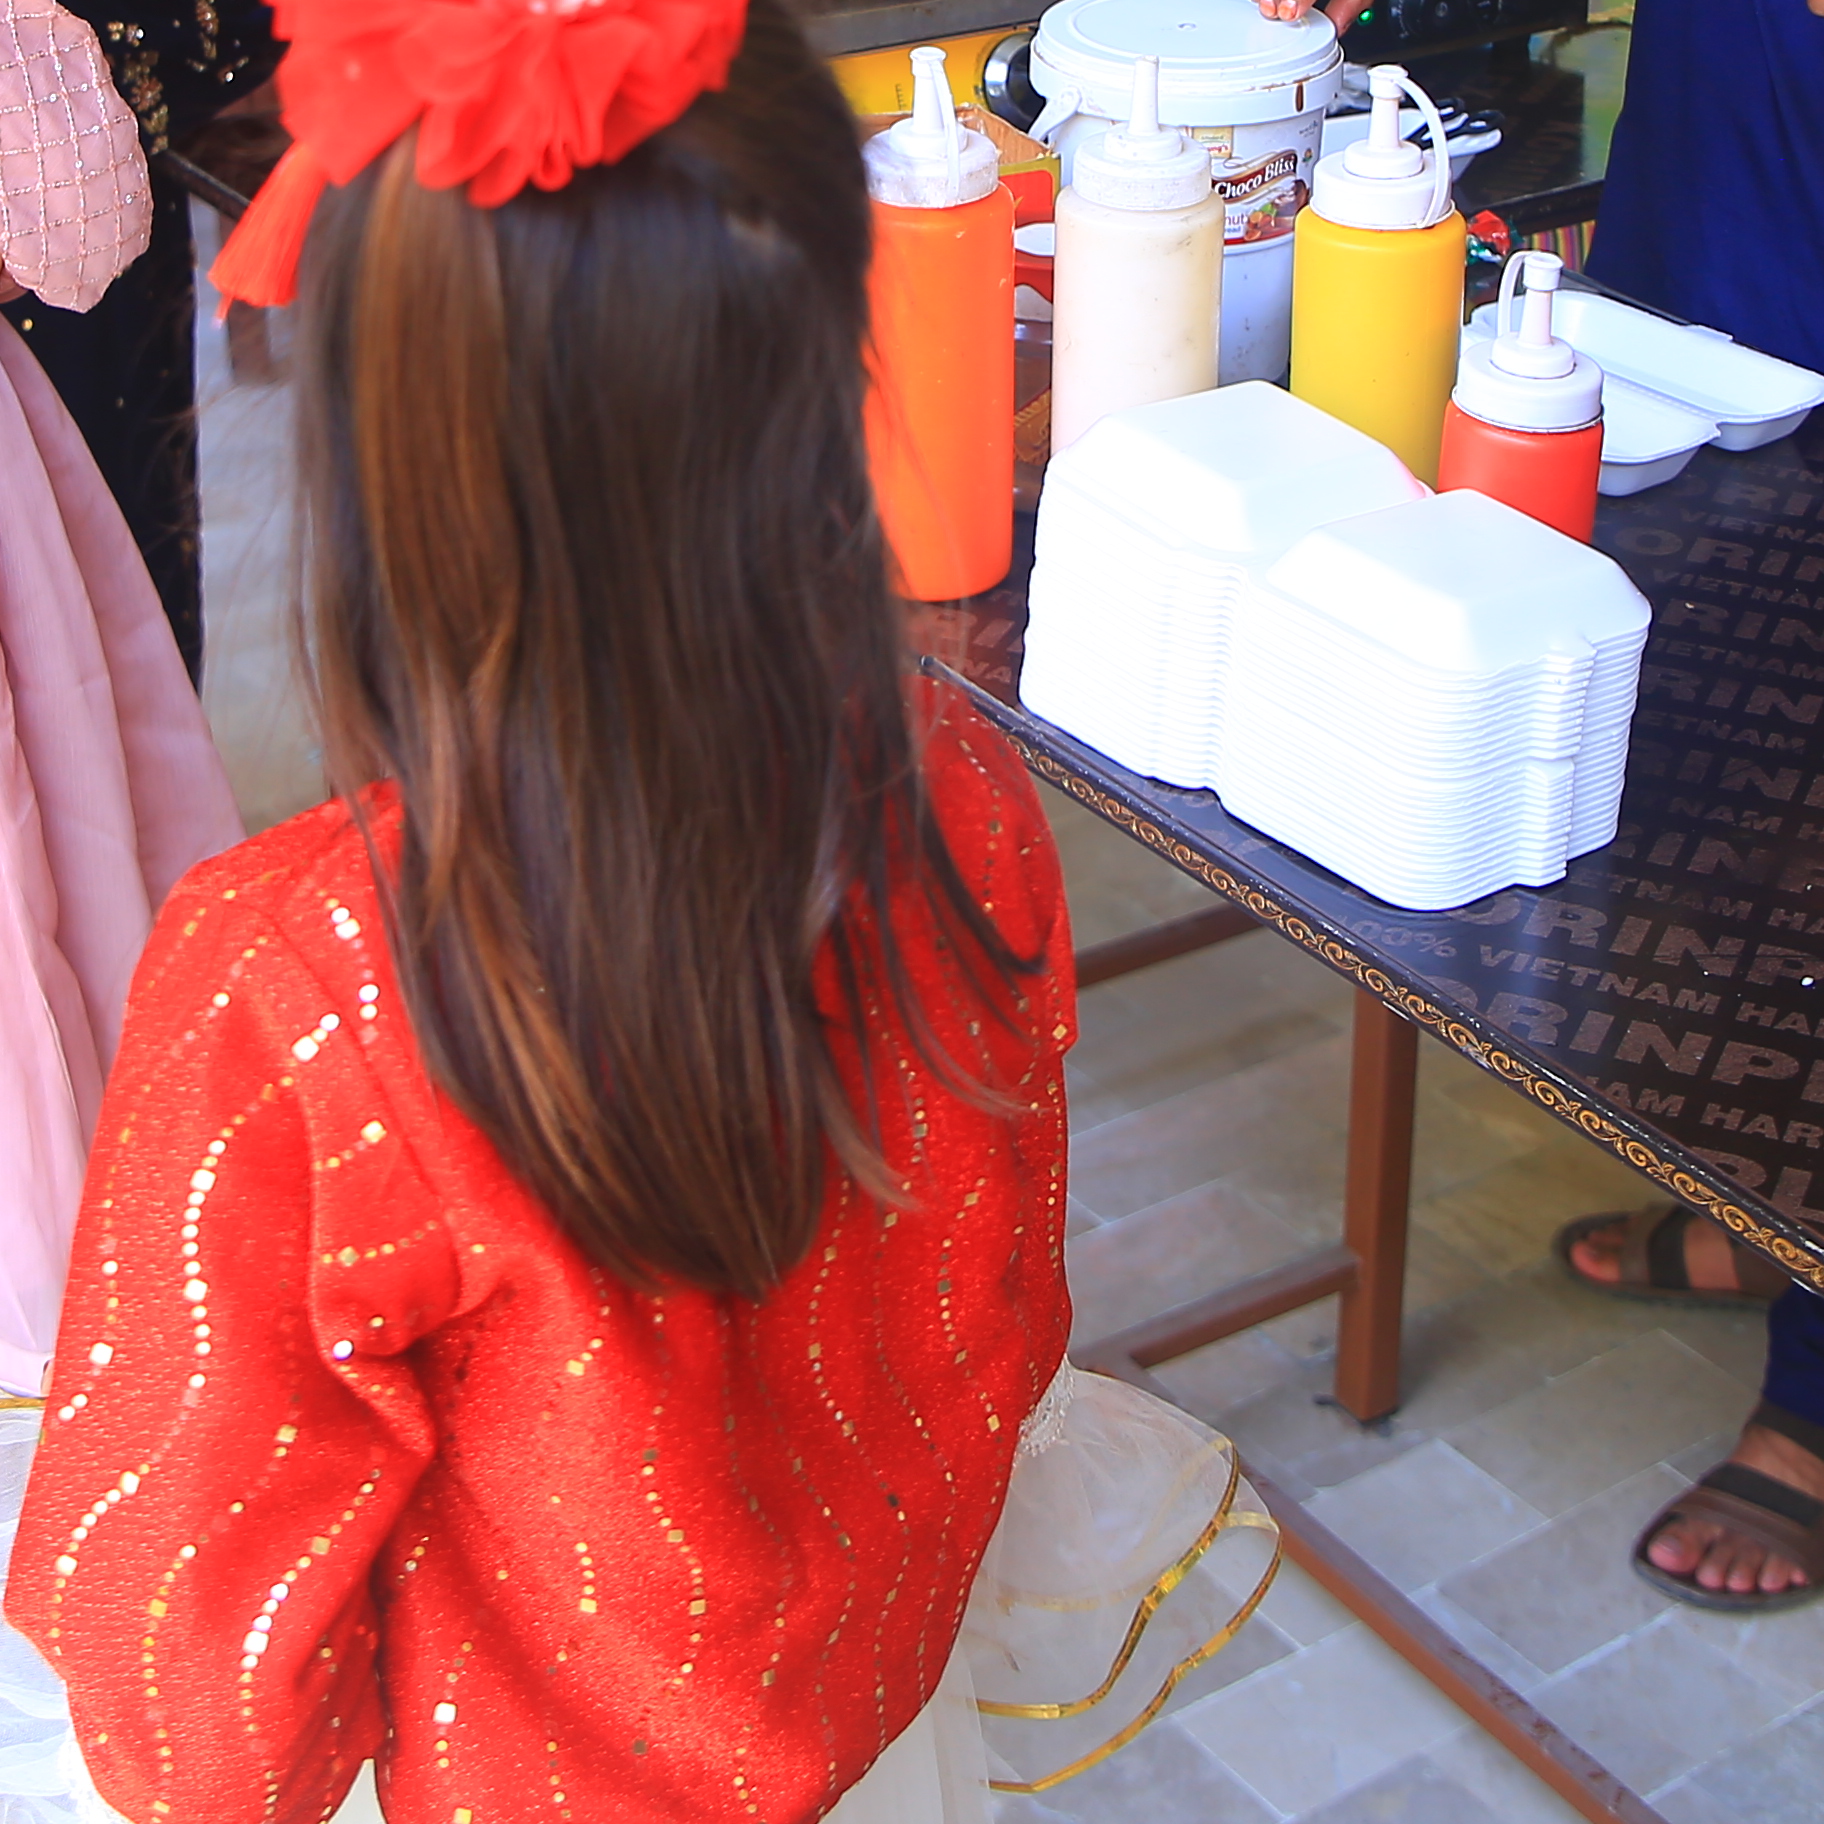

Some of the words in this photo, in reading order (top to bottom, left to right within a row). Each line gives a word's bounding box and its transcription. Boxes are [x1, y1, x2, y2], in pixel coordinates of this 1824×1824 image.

[1214, 176, 1263, 199] Choco
[1264, 154, 1296, 183] Bliss
[1638, 708, 1807, 755] ETNAM
[1569, 866, 1754, 921] ETNAM
[1352, 919, 1459, 959] 00%
[1479, 944, 1722, 1016] VIETNAM
